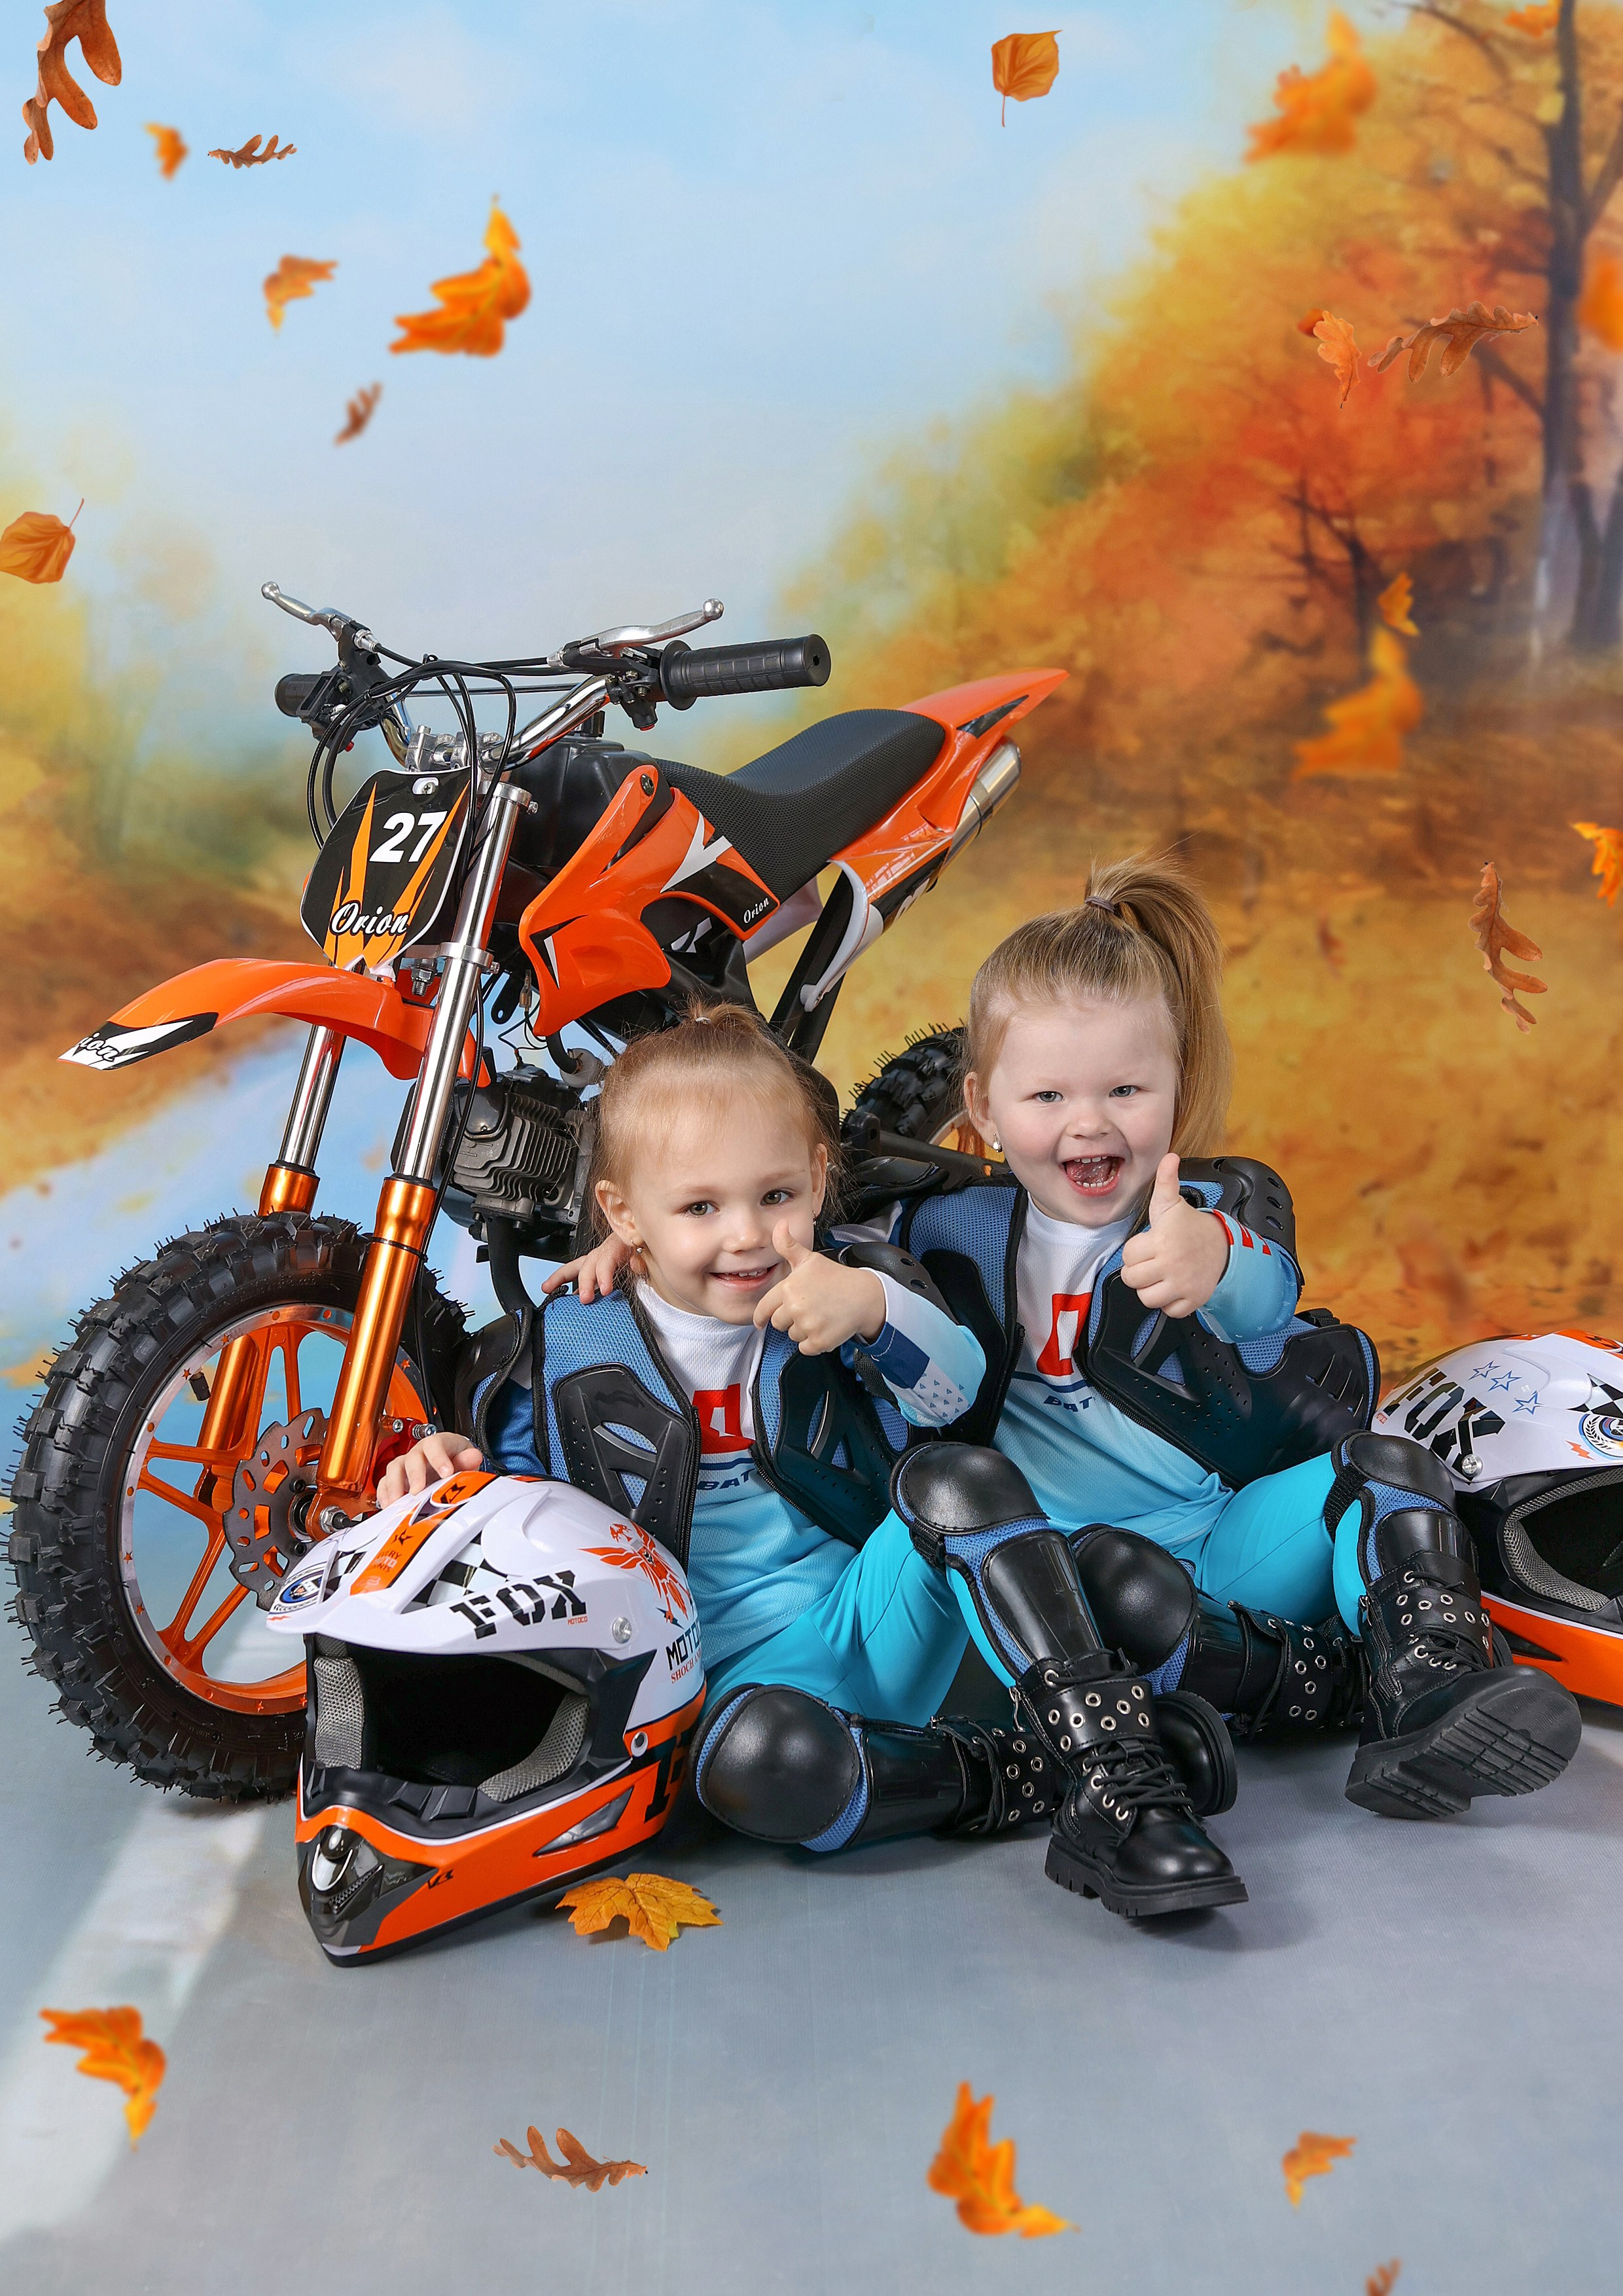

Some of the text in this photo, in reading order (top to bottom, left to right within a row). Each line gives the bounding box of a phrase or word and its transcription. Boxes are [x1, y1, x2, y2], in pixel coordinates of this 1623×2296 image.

[369, 811, 448, 863] 27
[330, 901, 408, 935] Orion
[743, 897, 770, 924] Orion
[1382, 1367, 1506, 1482] FOX
[449, 1570, 587, 1640] FOX
[567, 1616, 588, 1625] MOTOCO
